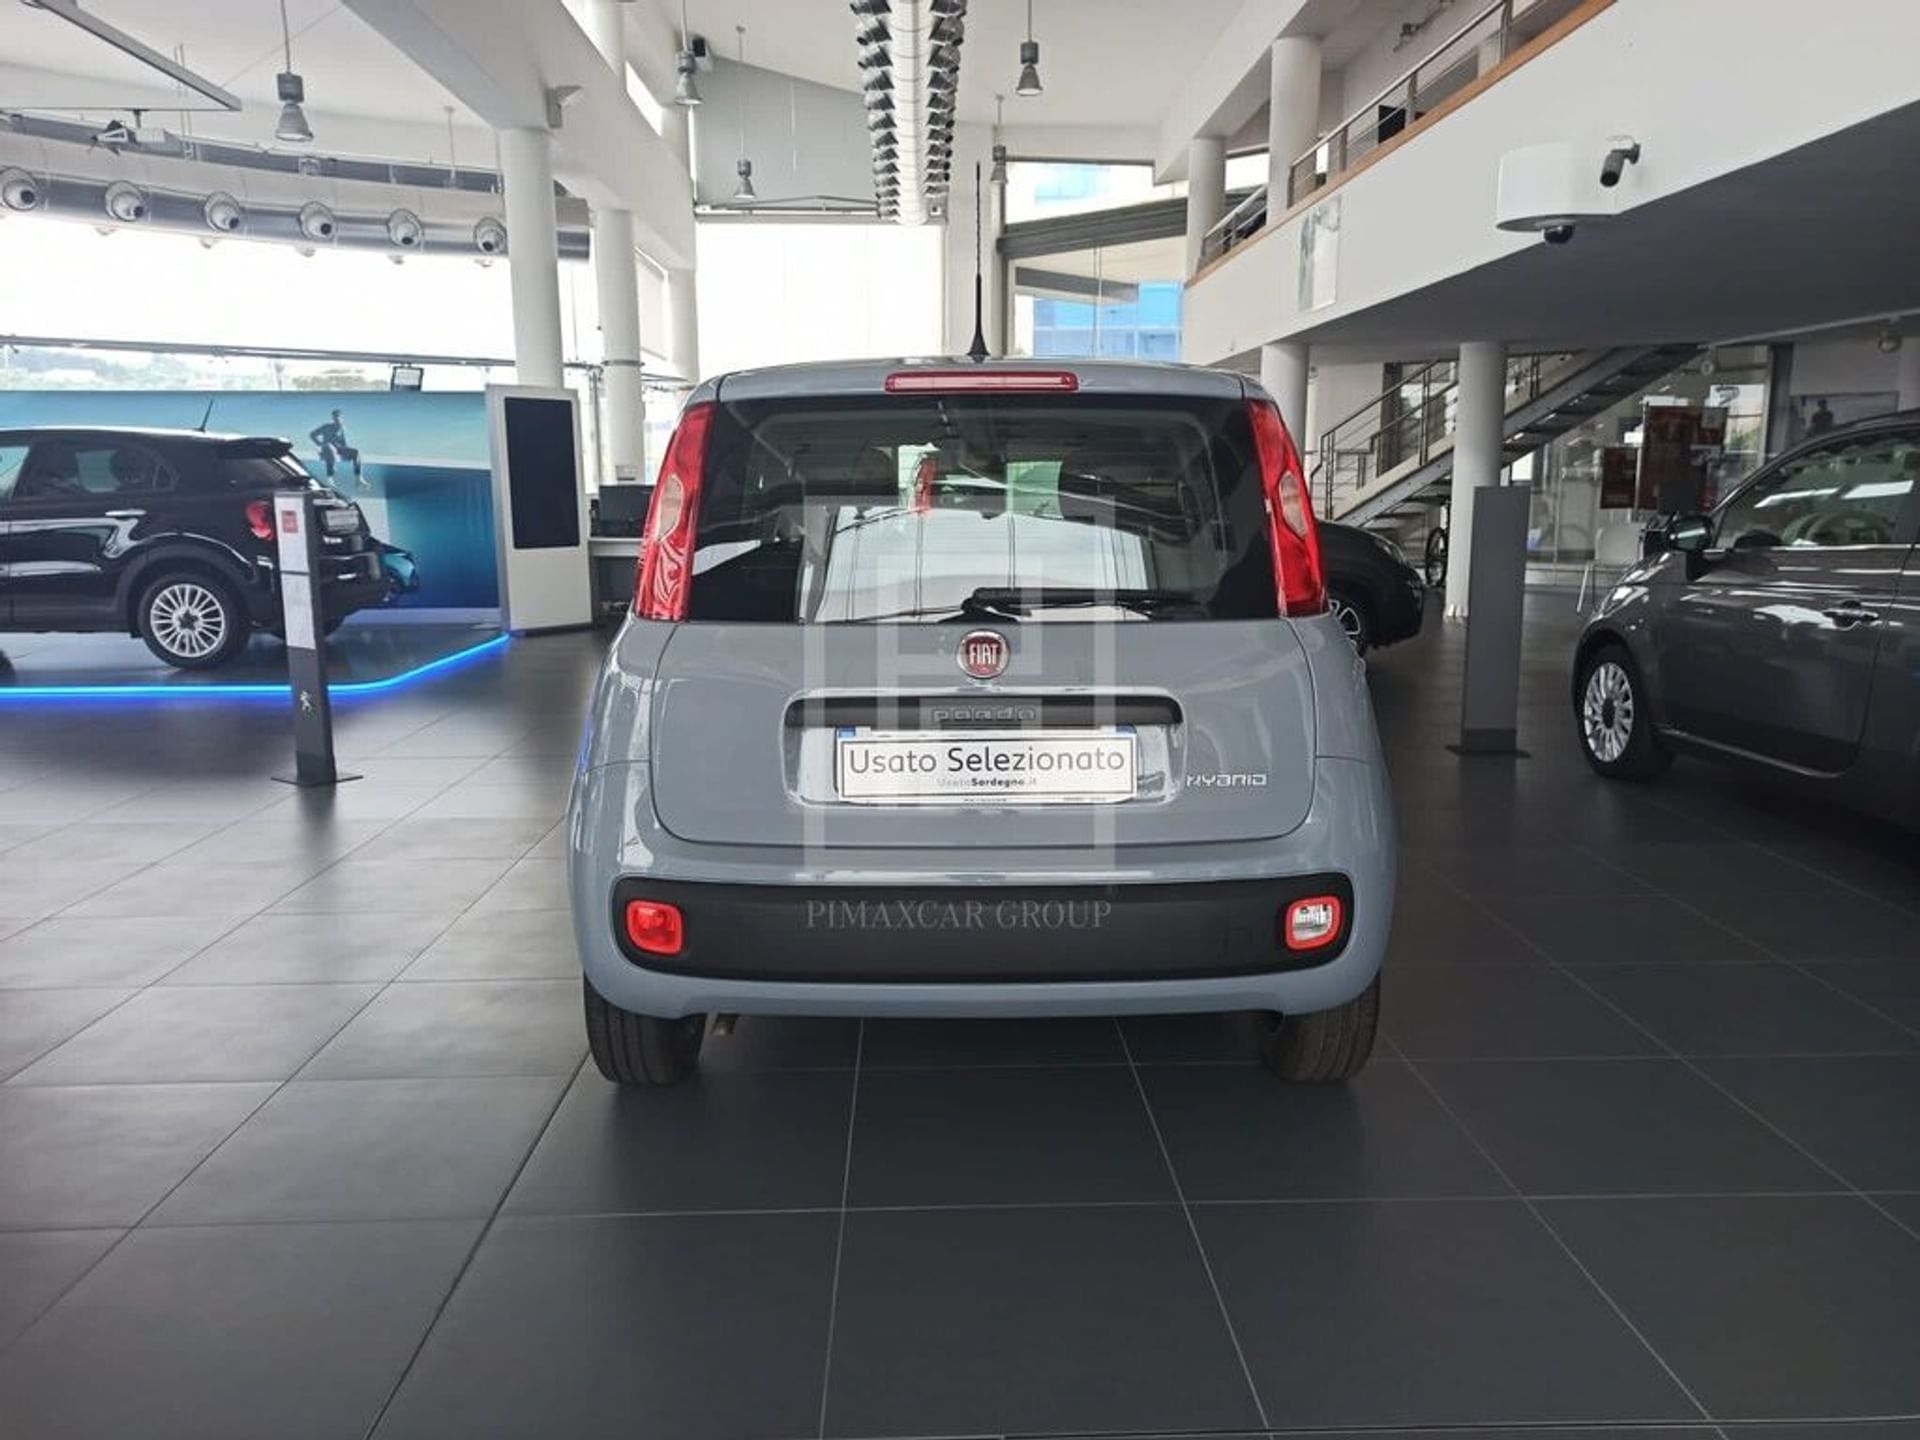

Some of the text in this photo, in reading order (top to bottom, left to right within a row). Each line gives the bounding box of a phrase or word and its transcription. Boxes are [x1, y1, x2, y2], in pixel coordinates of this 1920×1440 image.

[969, 643, 999, 665] FIAT
[850, 746, 1125, 773] Usato Selezionato
